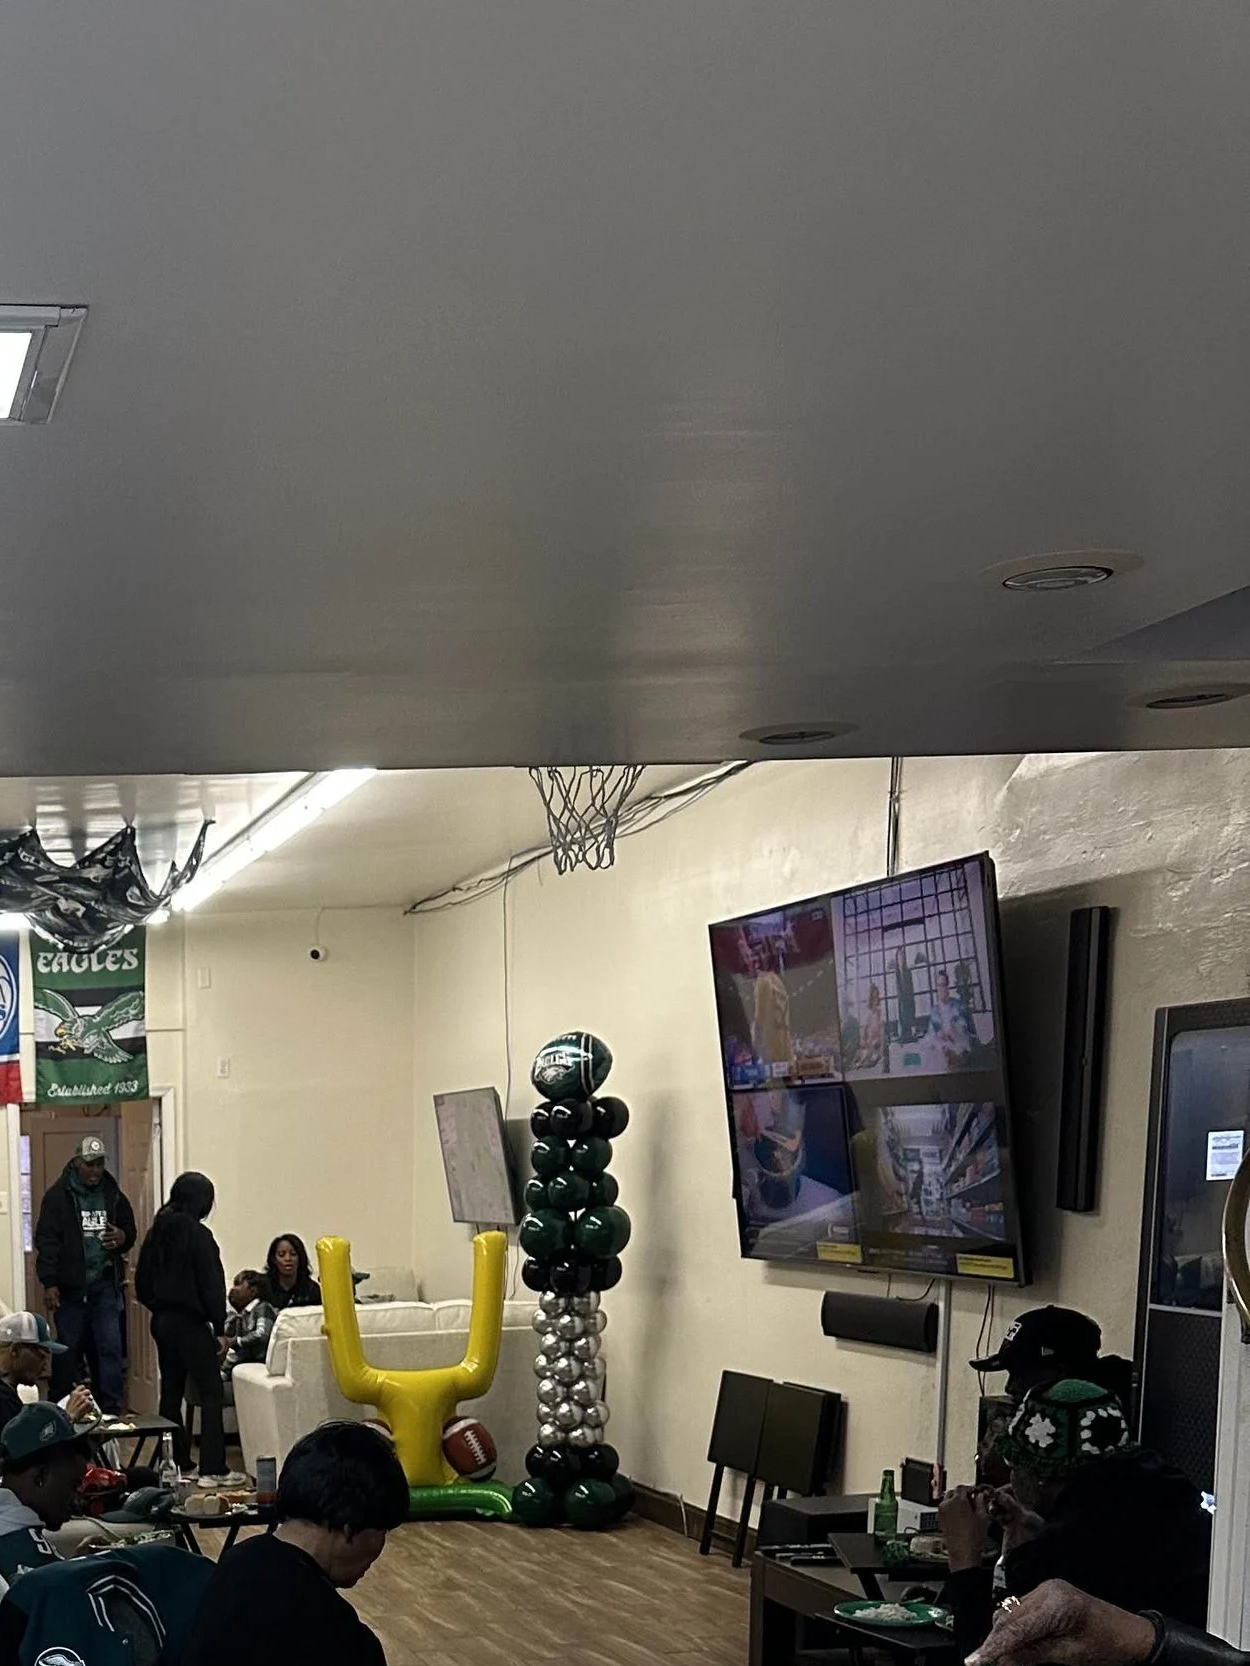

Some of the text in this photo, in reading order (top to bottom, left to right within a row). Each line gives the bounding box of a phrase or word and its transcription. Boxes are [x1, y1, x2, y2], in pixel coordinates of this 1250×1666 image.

[37, 949, 139, 974] EAGLES
[47, 1080, 138, 1097] Established 1933
